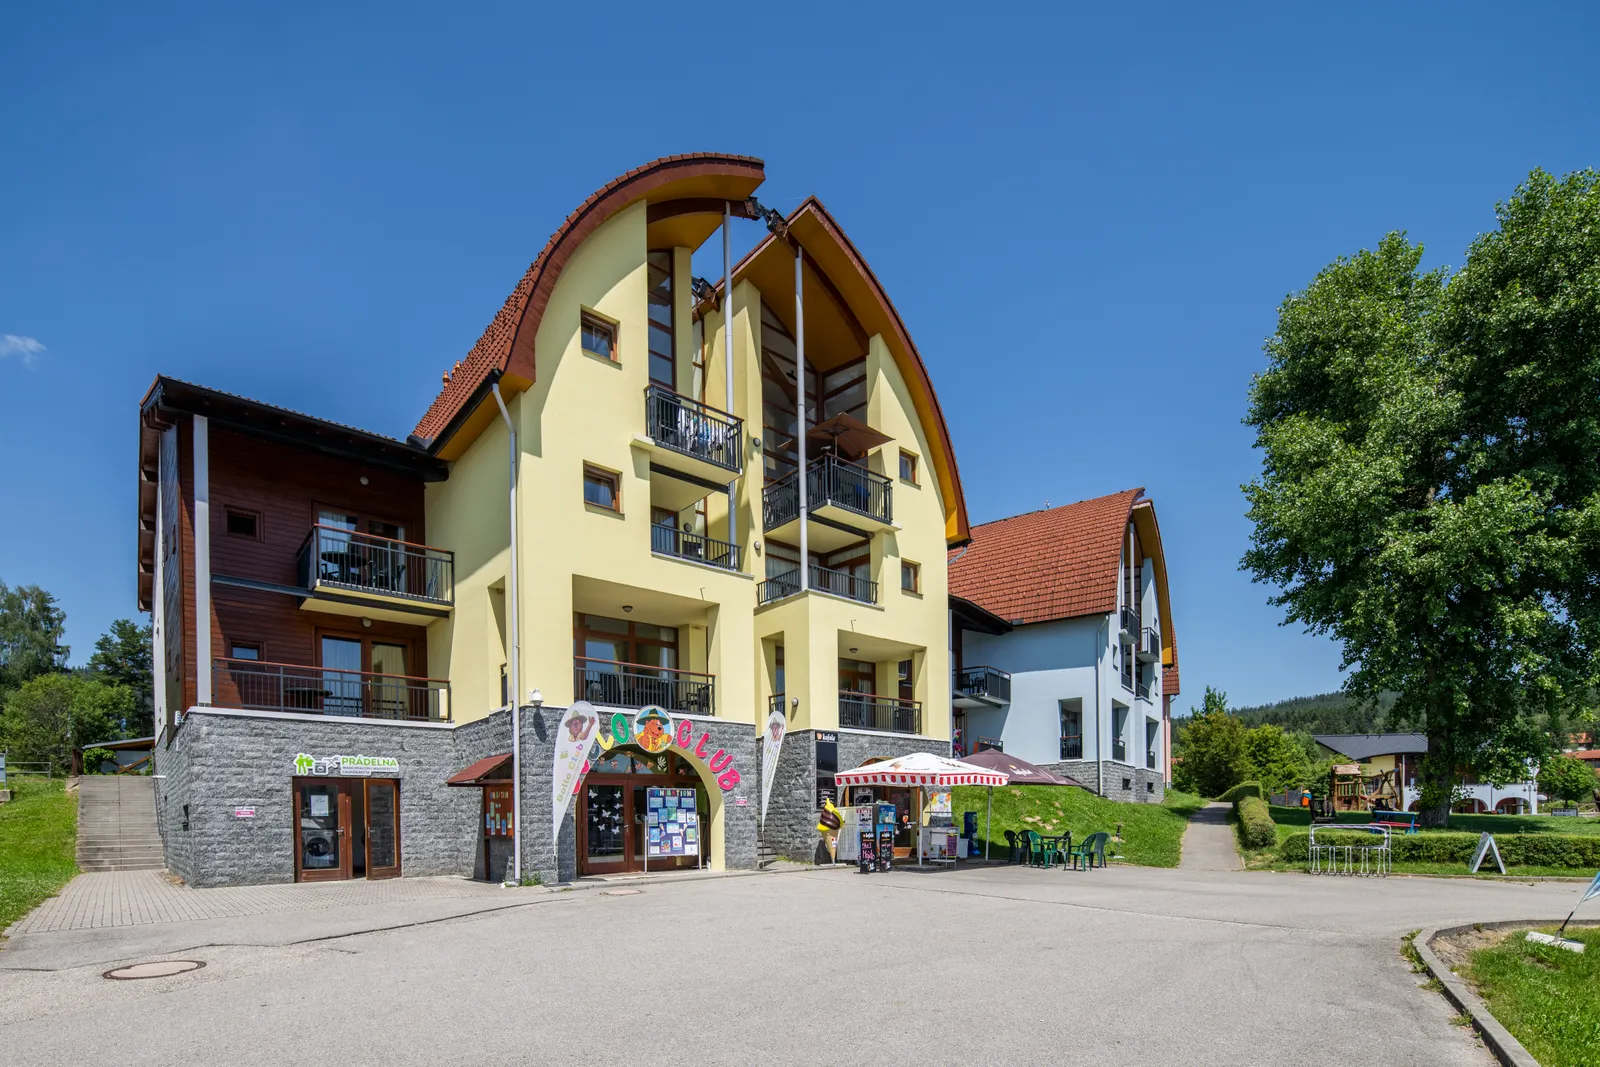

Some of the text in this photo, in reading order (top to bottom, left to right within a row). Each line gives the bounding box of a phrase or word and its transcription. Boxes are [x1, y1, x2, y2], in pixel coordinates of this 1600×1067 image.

[677, 719, 741, 791] CLUB
[342, 756, 397, 766] PRÁDELNA
[654, 789, 692, 797] ANIMATION
